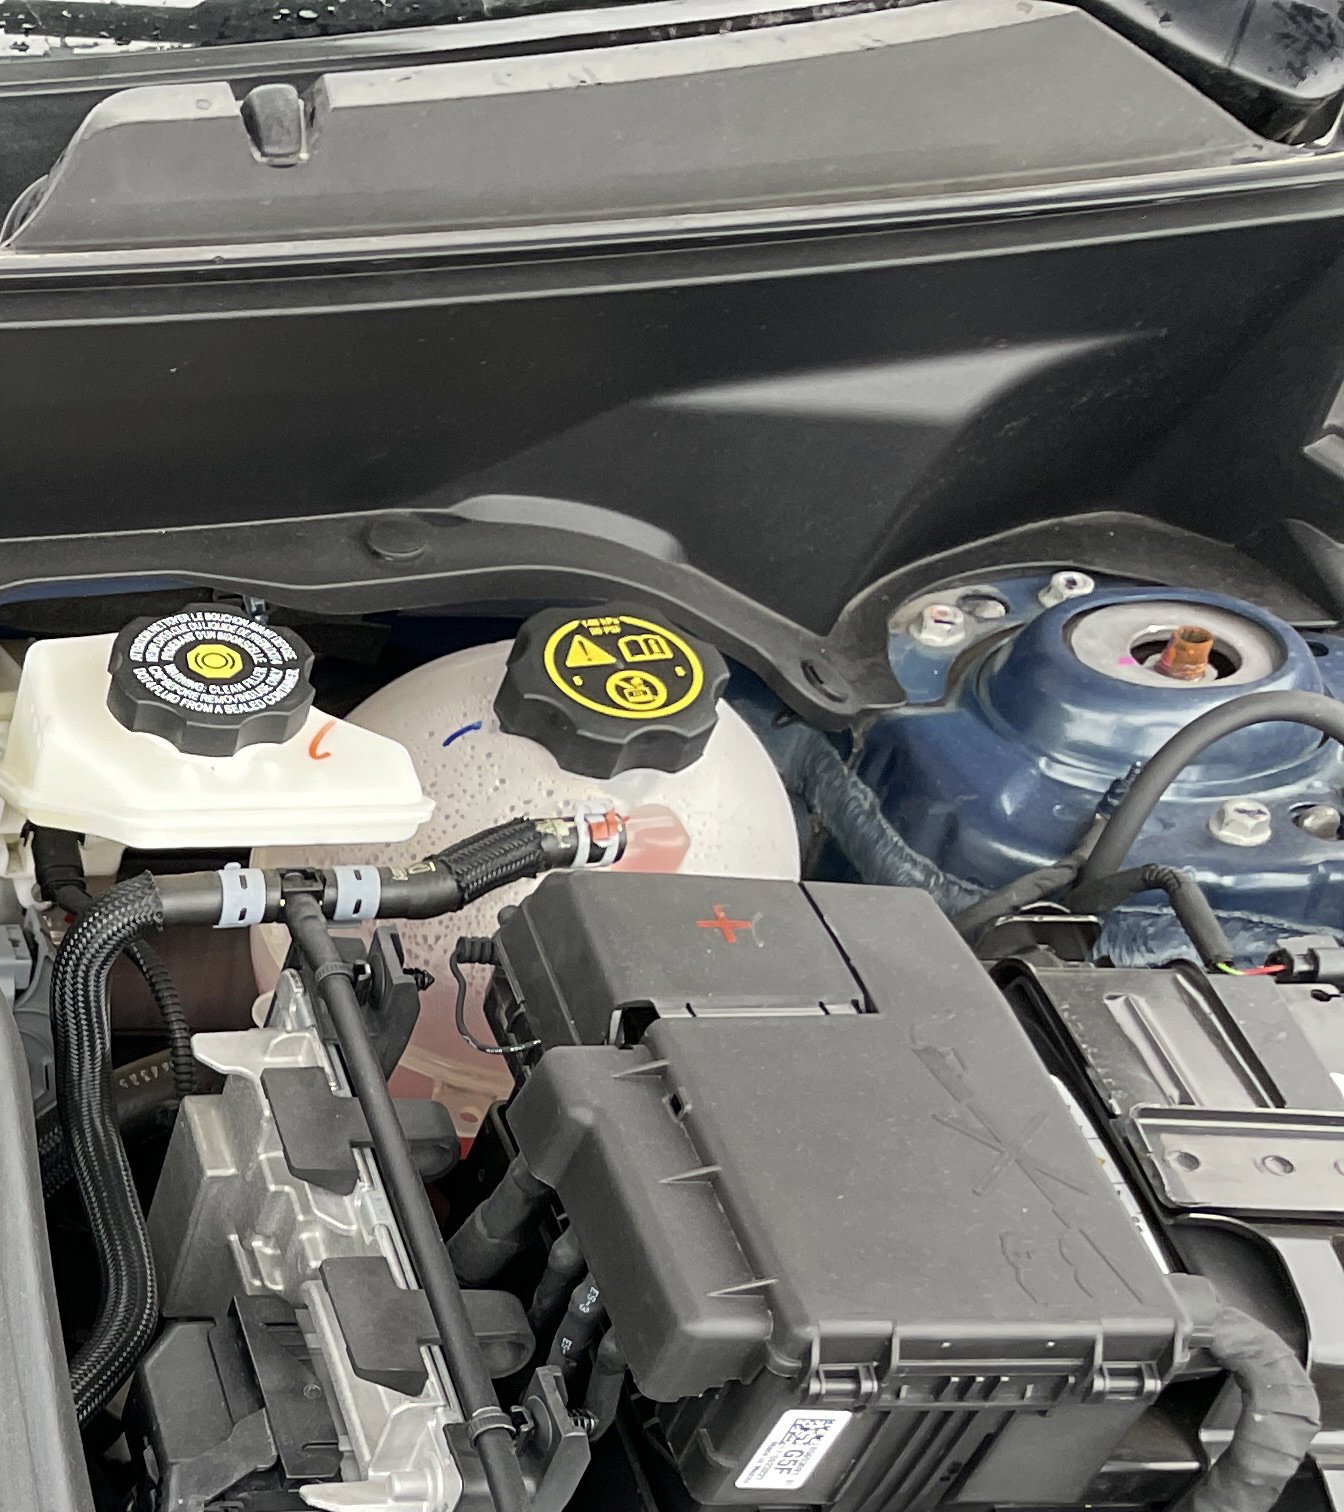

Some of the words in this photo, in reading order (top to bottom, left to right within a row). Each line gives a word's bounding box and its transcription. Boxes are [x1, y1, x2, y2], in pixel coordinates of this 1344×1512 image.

[190, 611, 204, 622] LE
[178, 697, 214, 713] FROM
[213, 704, 224, 715] A
[223, 698, 267, 715] SEALED
[771, 1449, 805, 1474] G5F
